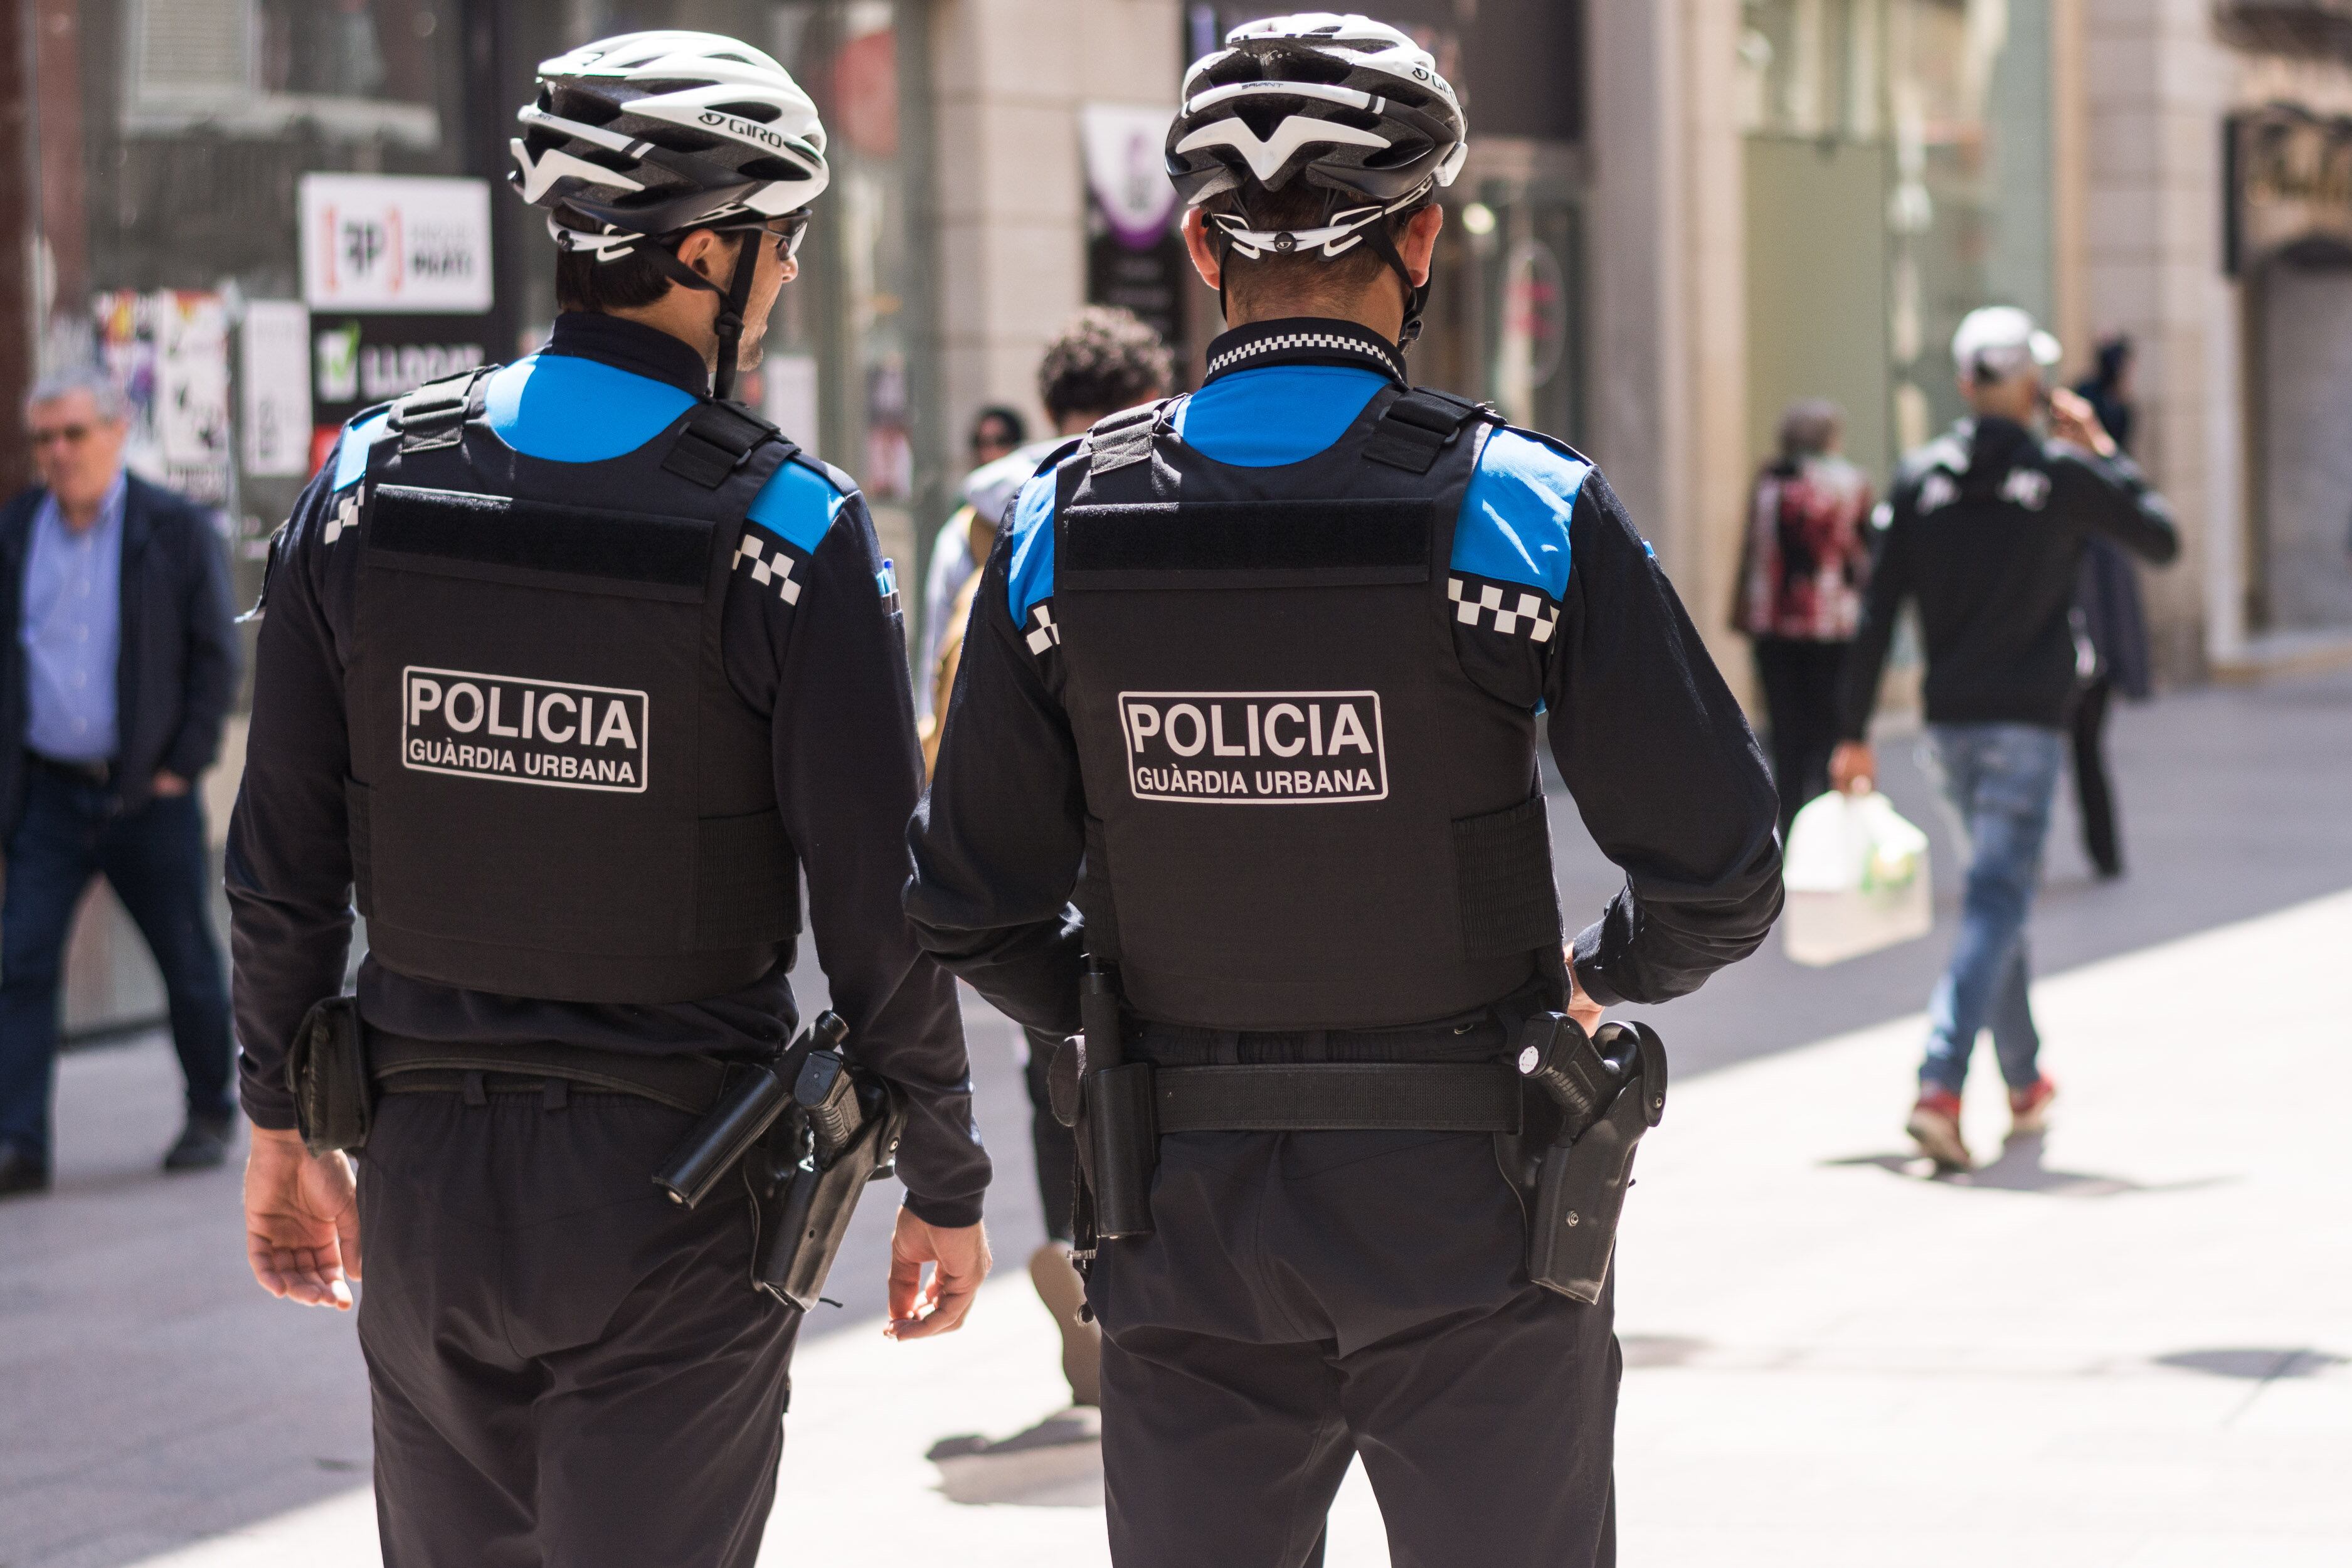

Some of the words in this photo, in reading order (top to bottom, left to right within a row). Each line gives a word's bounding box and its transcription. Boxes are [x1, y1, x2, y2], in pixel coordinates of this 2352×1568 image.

[1242, 82, 1284, 90] SAVANT
[729, 119, 782, 148] GIRO
[411, 678, 637, 749] POLICIA
[1128, 703, 1373, 757] POLICIA
[410, 737, 516, 772] GUÀRDIA
[524, 752, 635, 783] URBANA
[1137, 763, 1248, 793] GUÀRDIA
[1256, 768, 1375, 794] URBANA
